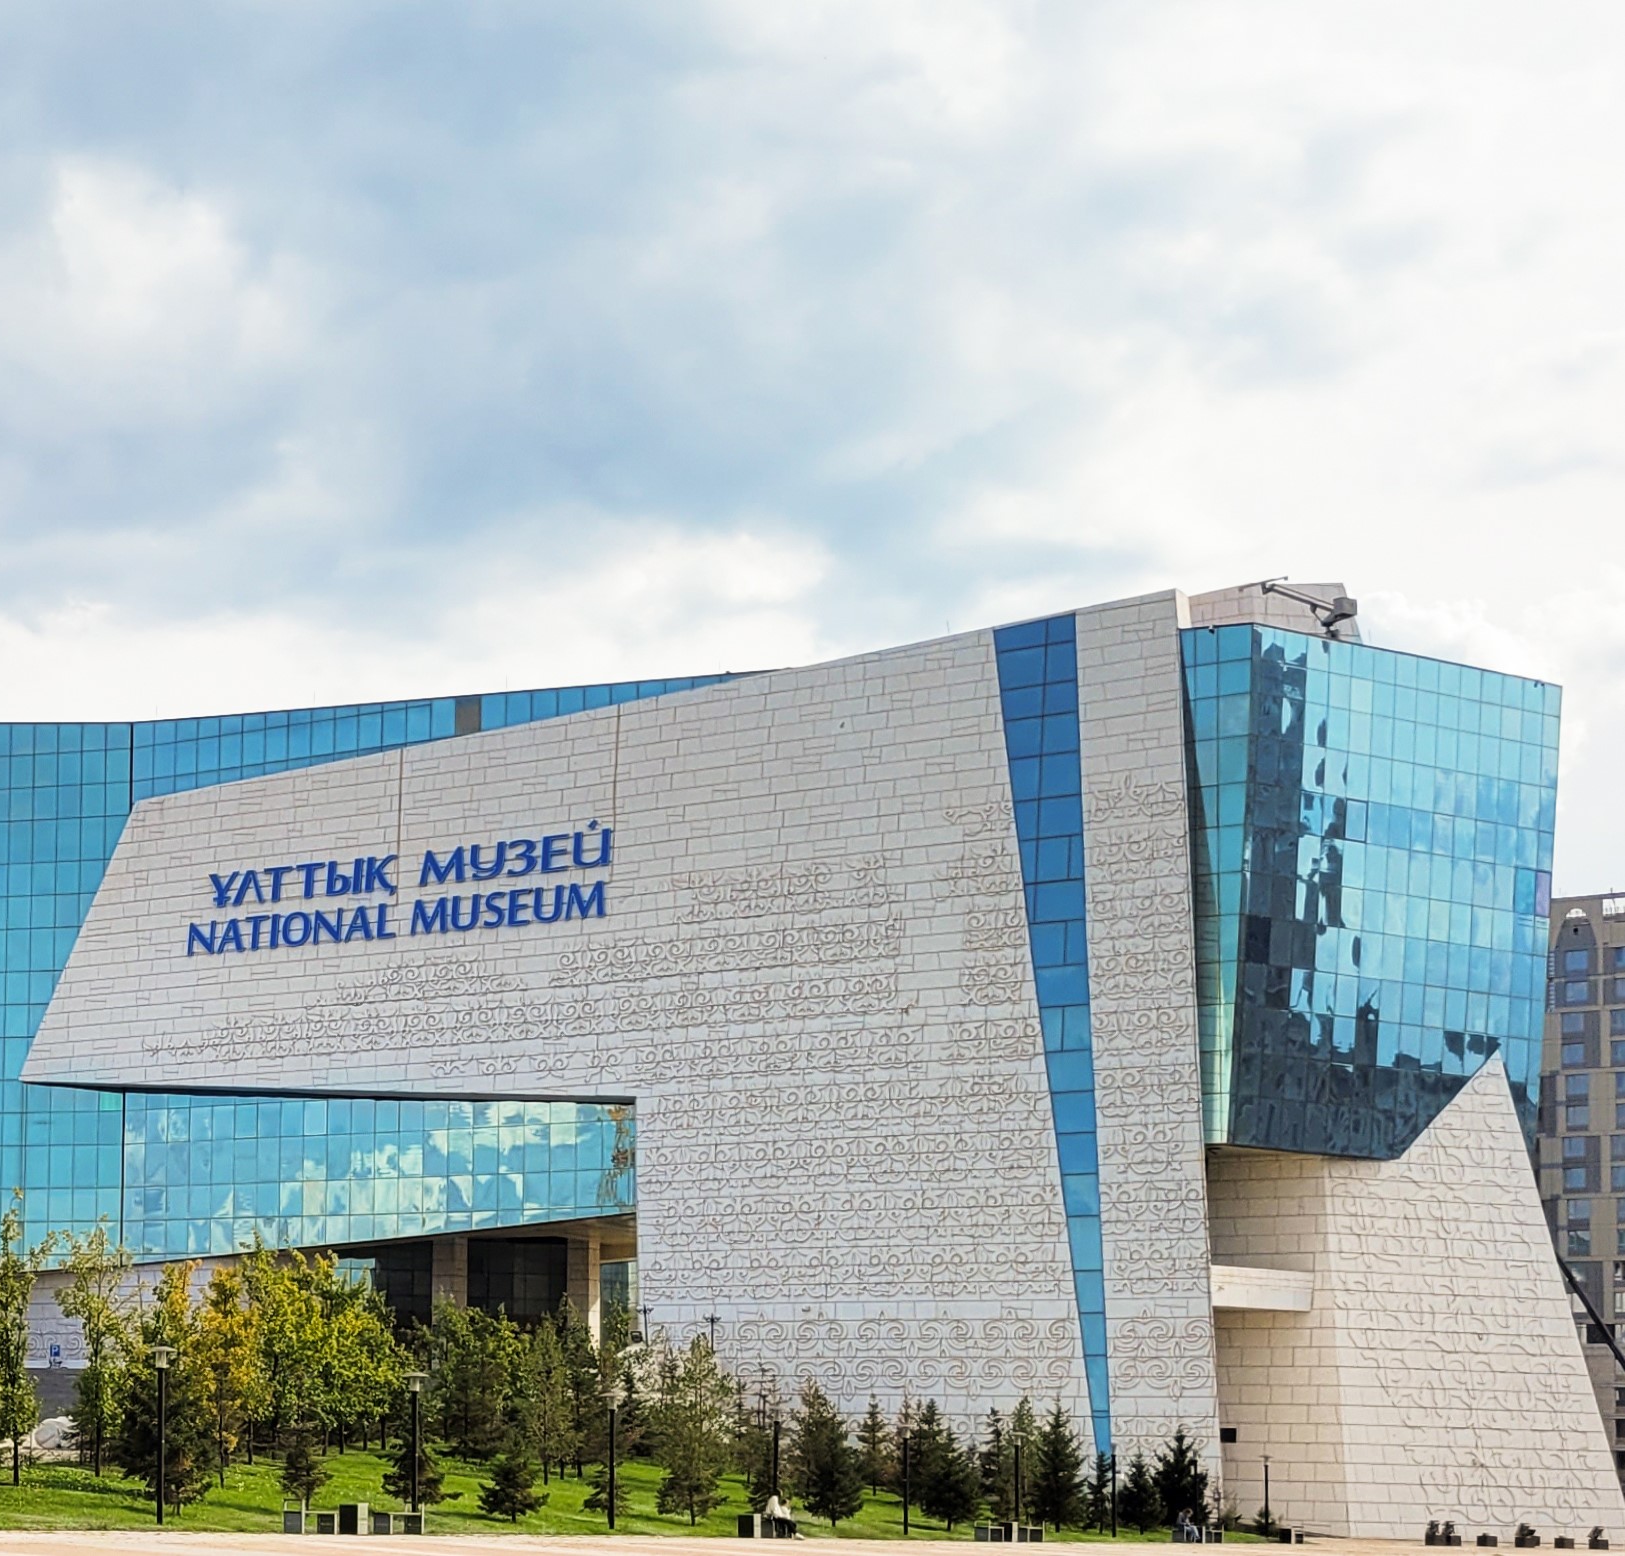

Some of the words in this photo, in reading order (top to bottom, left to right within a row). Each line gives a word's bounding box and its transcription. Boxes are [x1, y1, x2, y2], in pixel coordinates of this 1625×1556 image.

[209, 854, 397, 908] ҰЛТТЫҚ
[419, 818, 613, 887] МУЗЕЙ
[187, 903, 396, 957] NATIONAL
[410, 881, 606, 937] MUSEUM
